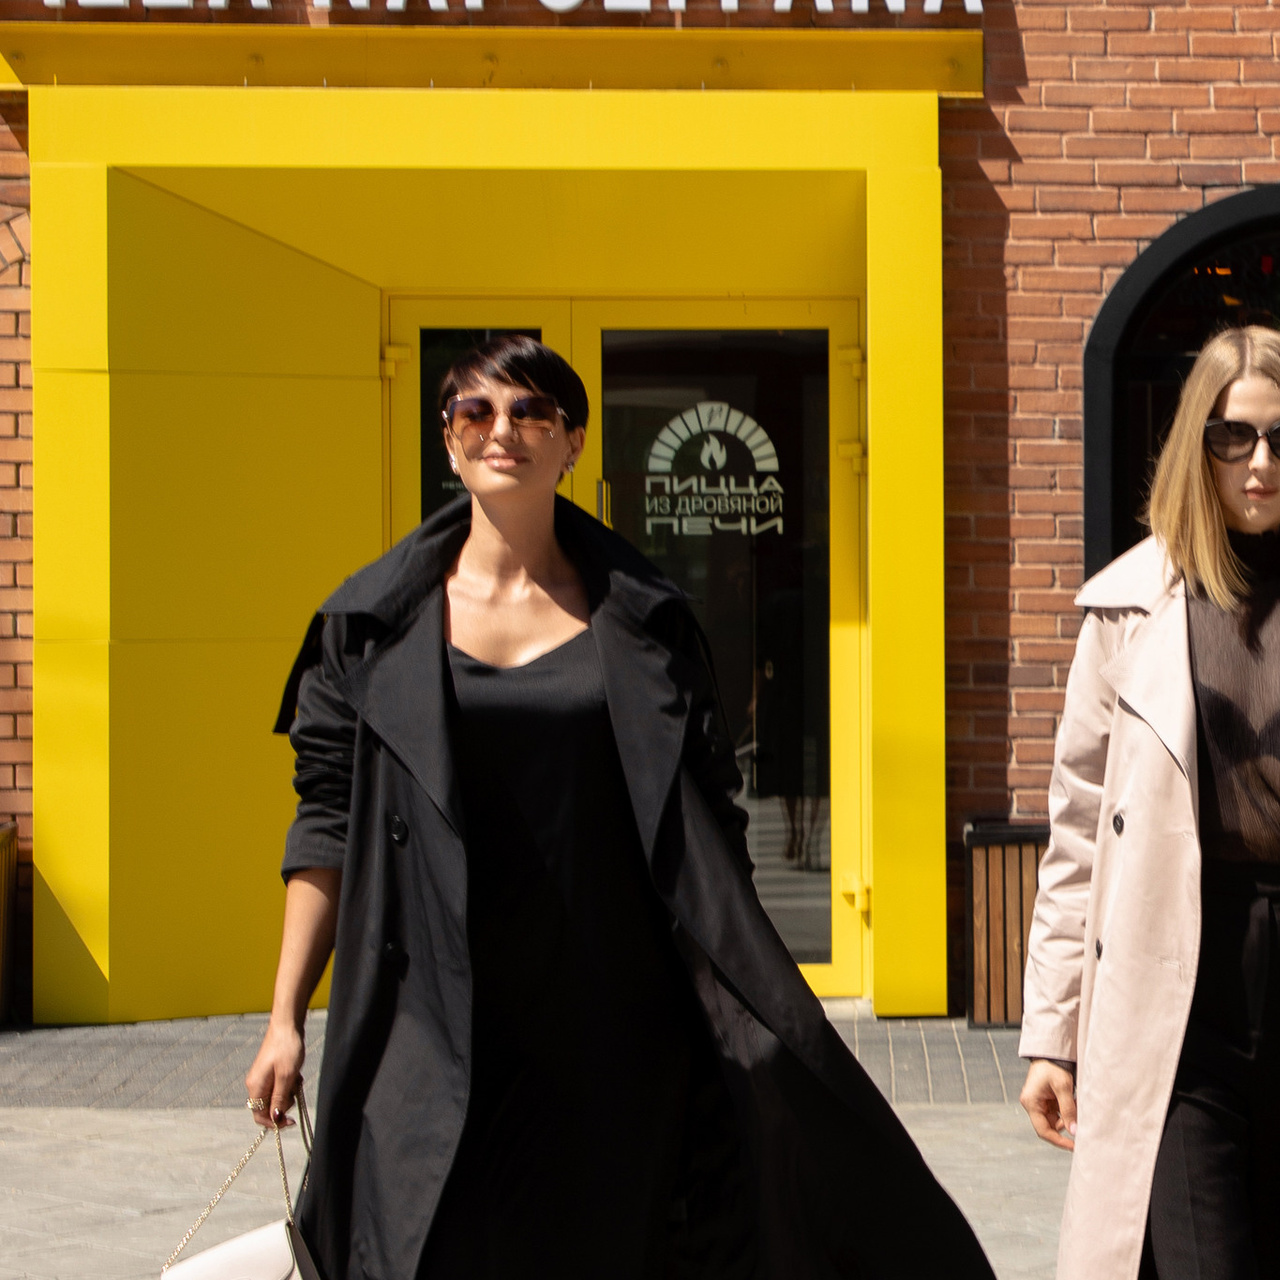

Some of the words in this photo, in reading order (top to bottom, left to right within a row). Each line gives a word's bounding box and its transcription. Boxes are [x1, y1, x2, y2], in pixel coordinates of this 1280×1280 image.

[645, 474, 784, 496] ПИЦЦА
[645, 496, 671, 514] ИЗ
[675, 493, 784, 516] ДРОВЯНОЙ
[645, 516, 784, 536] ПЕЧИ
